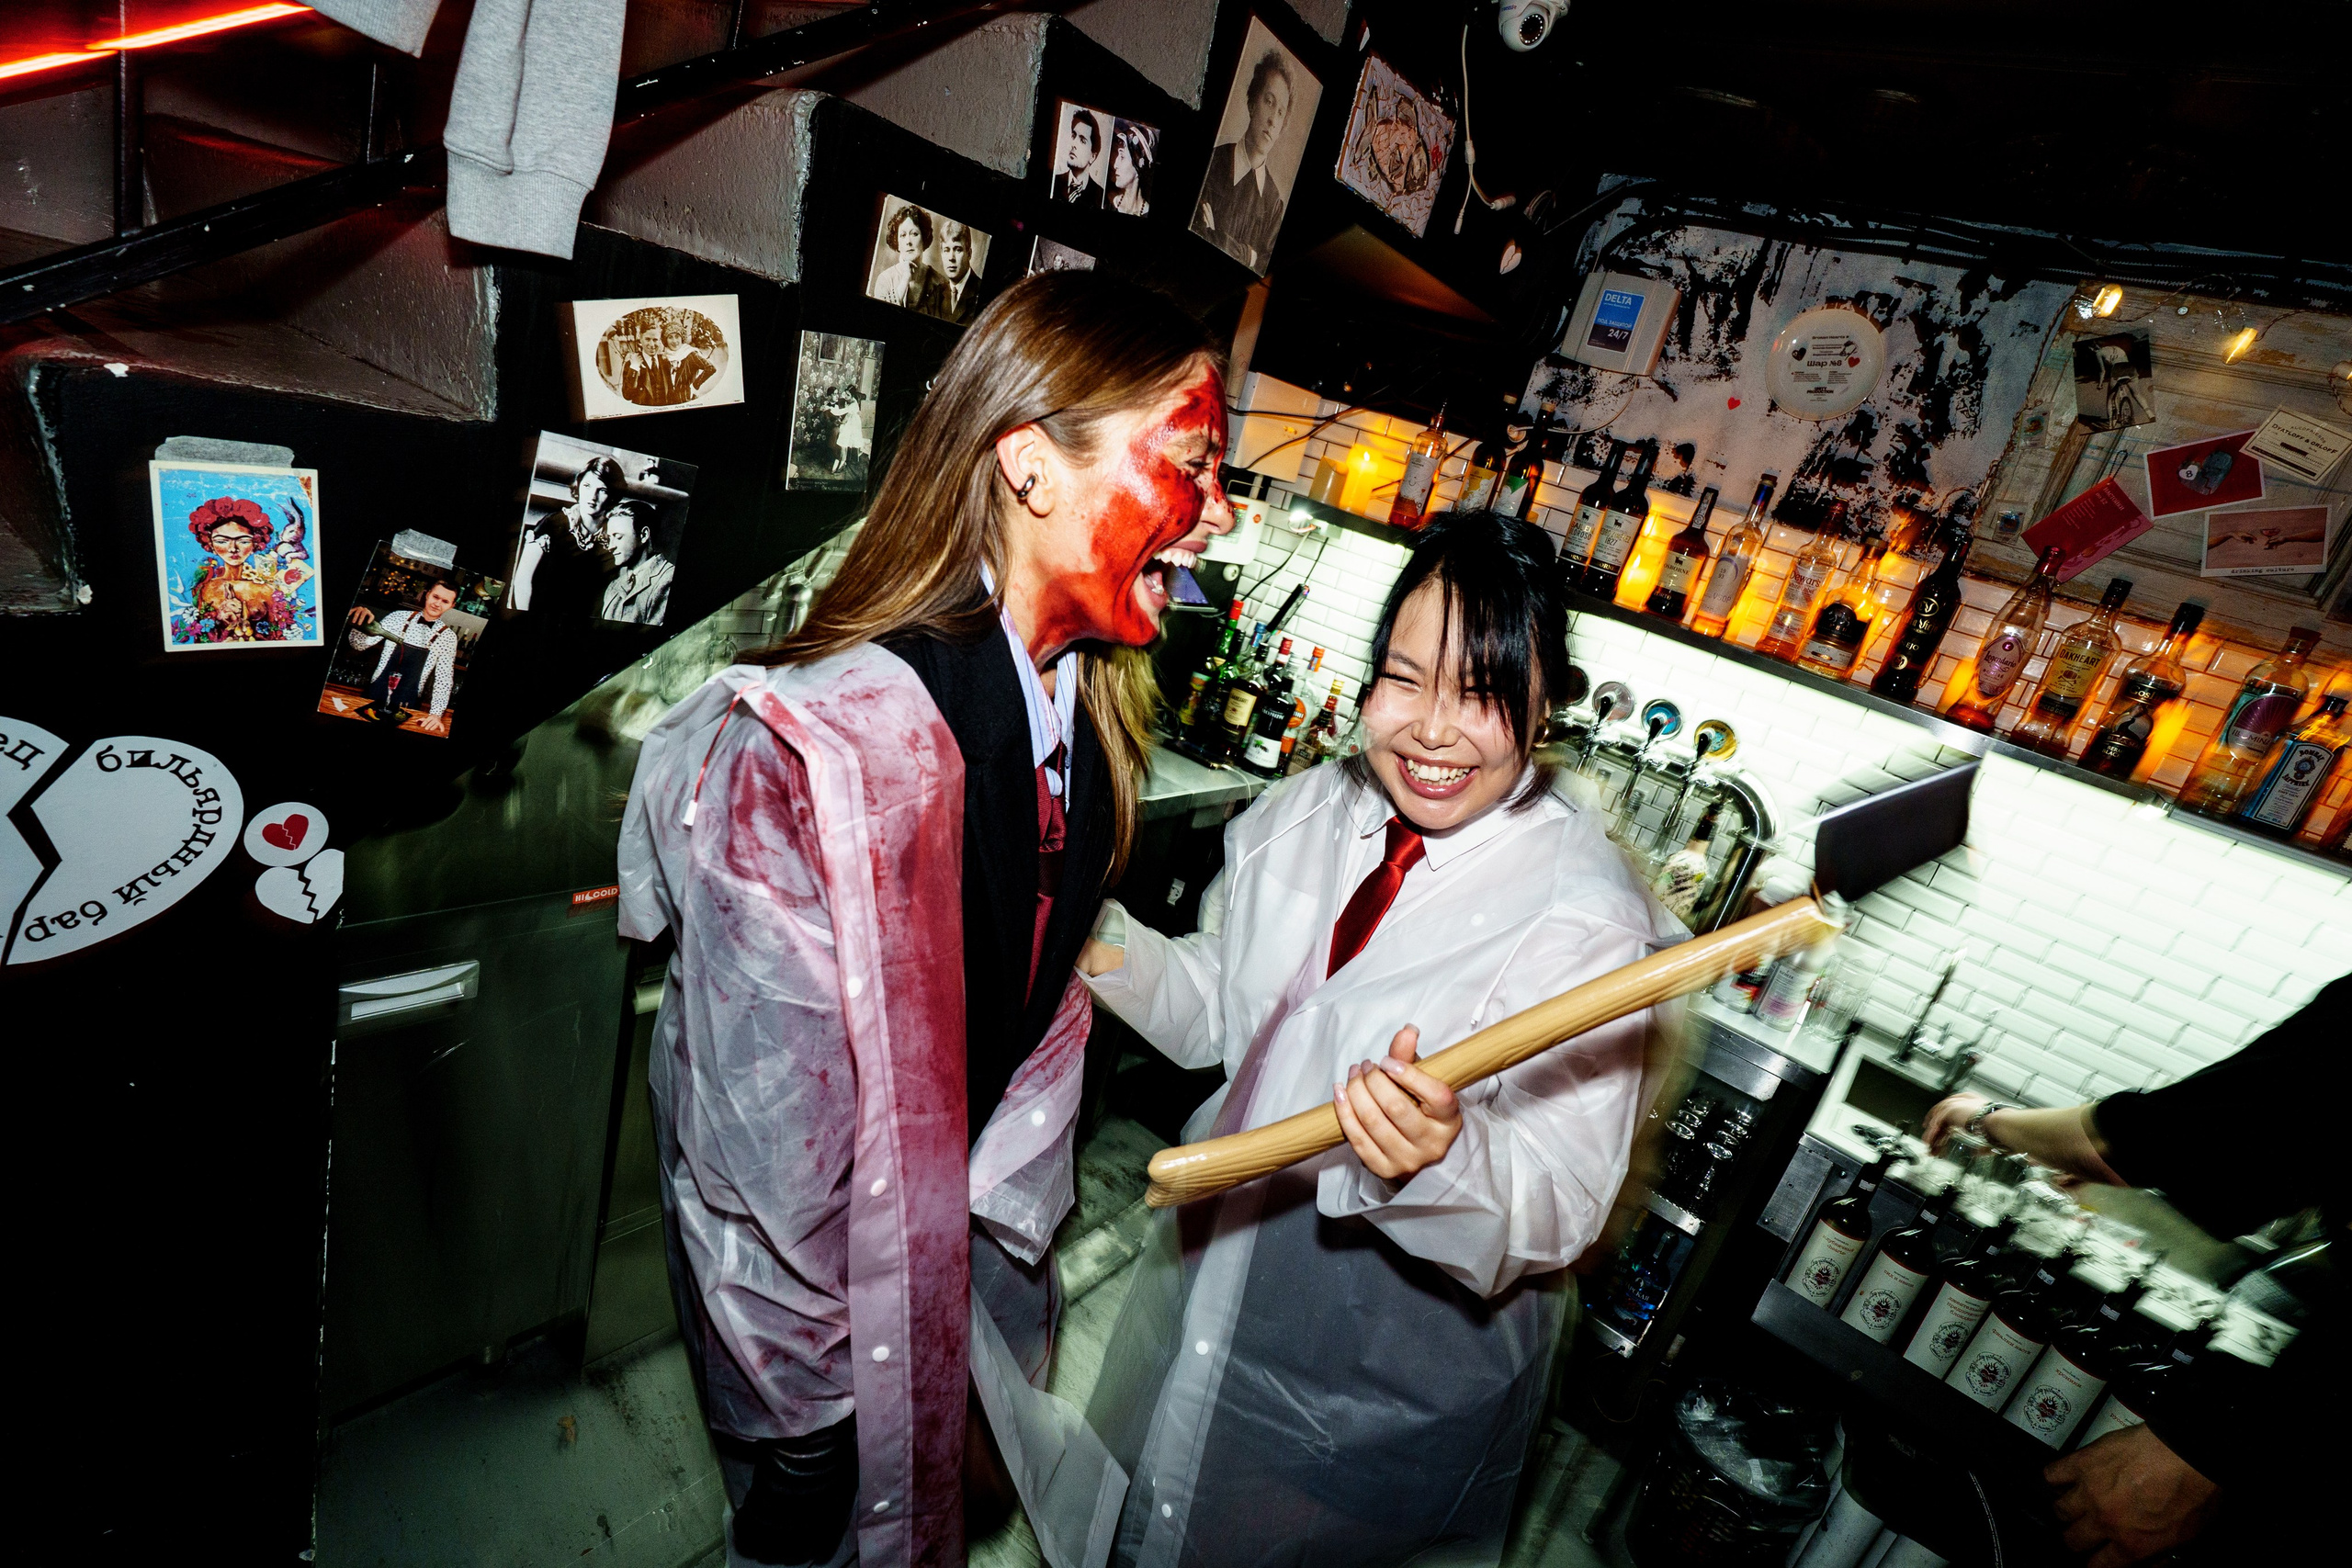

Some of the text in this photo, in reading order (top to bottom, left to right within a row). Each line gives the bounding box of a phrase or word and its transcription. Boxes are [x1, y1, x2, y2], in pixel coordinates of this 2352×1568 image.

[1604, 292, 1633, 306] DELTA
[1609, 320, 1633, 329] ЗАЩИТОЙ
[1608, 329, 1629, 340] 24/7
[2271, 423, 2304, 443] DYATLOFF
[2311, 442, 2338, 455] ORLOFF
[2186, 469, 2193, 478] 8
[1604, 536, 1617, 546] 1827
[1663, 563, 1690, 574] OSBORNE
[2231, 565, 2295, 575] drinking culture
[1712, 592, 1731, 603] VSOP
[1984, 650, 2017, 668] Legendario
[2059, 649, 2100, 667] OAKHEART
[2300, 749, 2324, 761] BOMBAY
[2282, 773, 2310, 786] SAPPHIRE
[24, 745, 222, 942] бильярдный бар
[1623, 1280, 1650, 1302] АРСКАЯ
